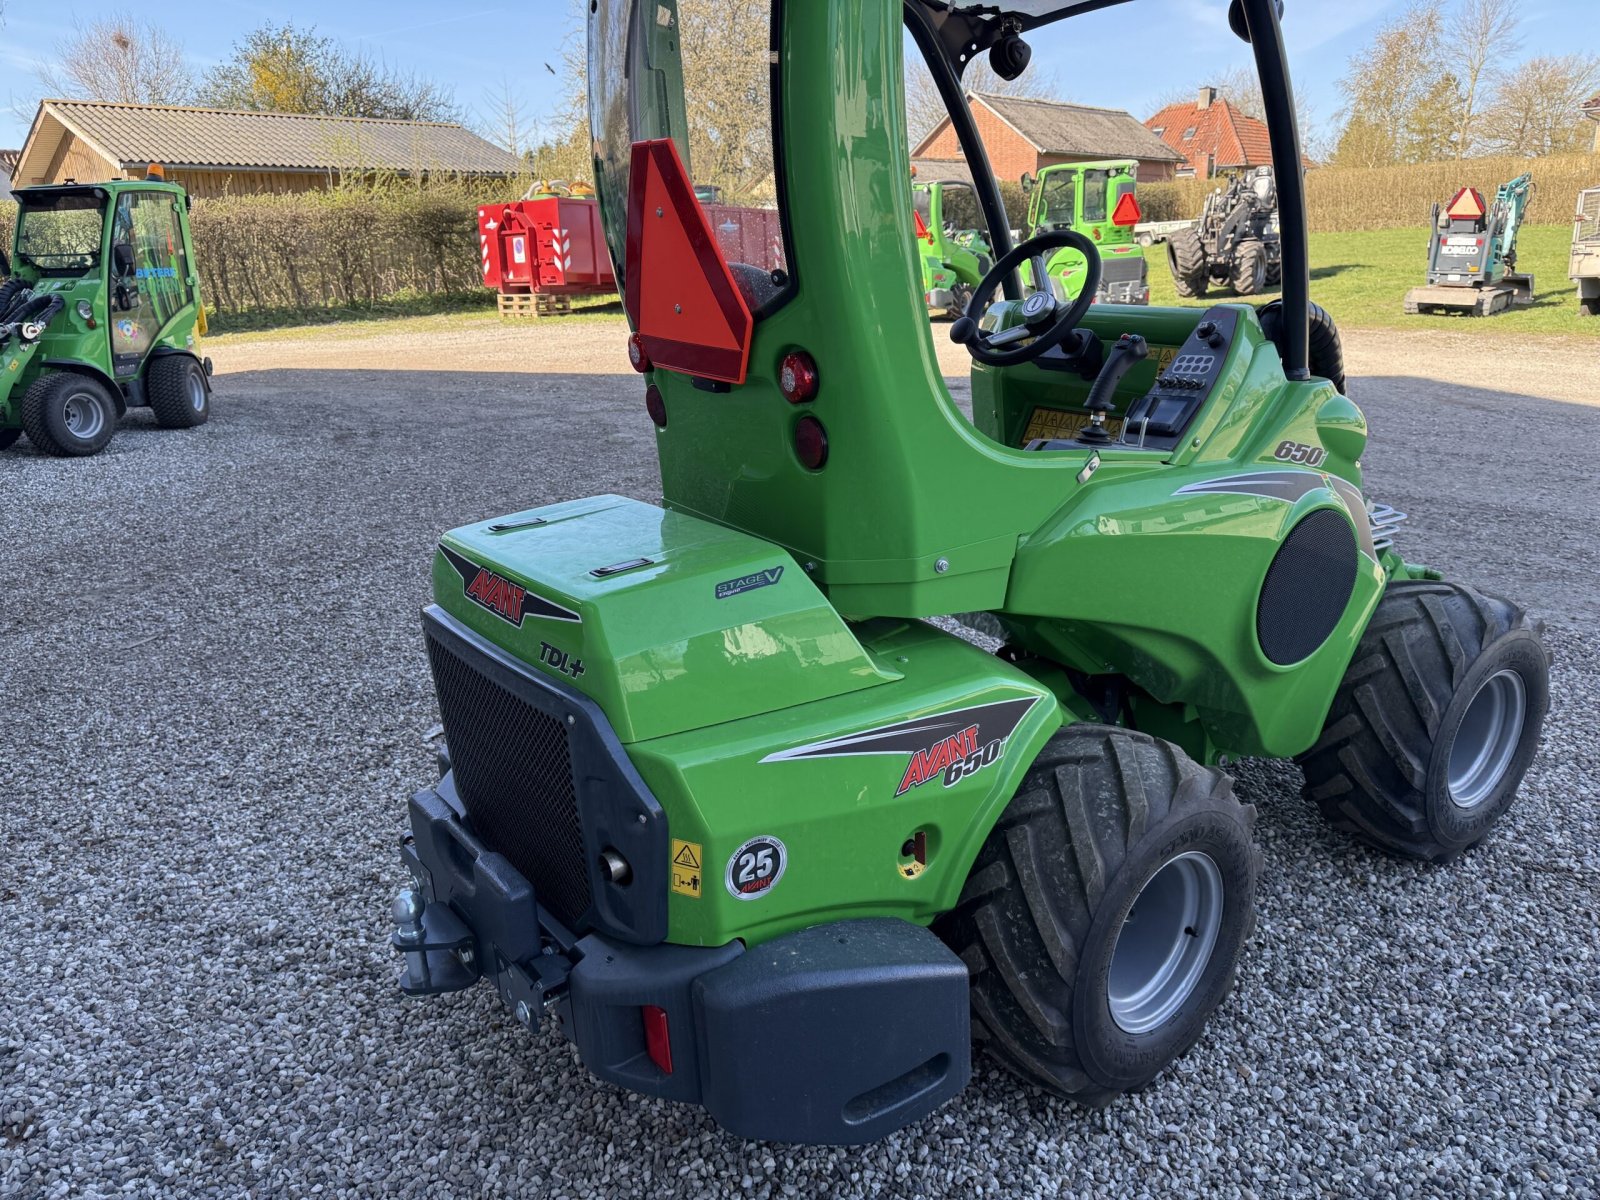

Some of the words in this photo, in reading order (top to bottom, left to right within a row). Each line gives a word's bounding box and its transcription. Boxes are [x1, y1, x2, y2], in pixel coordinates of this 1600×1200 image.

[466, 567, 526, 623] AVANT
[717, 573, 765, 592] STAGE
[764, 567, 782, 583] V
[539, 641, 586, 680] TDL+
[896, 724, 978, 795] AVANT
[738, 847, 773, 884] 25
[737, 875, 772, 896] AVANT
